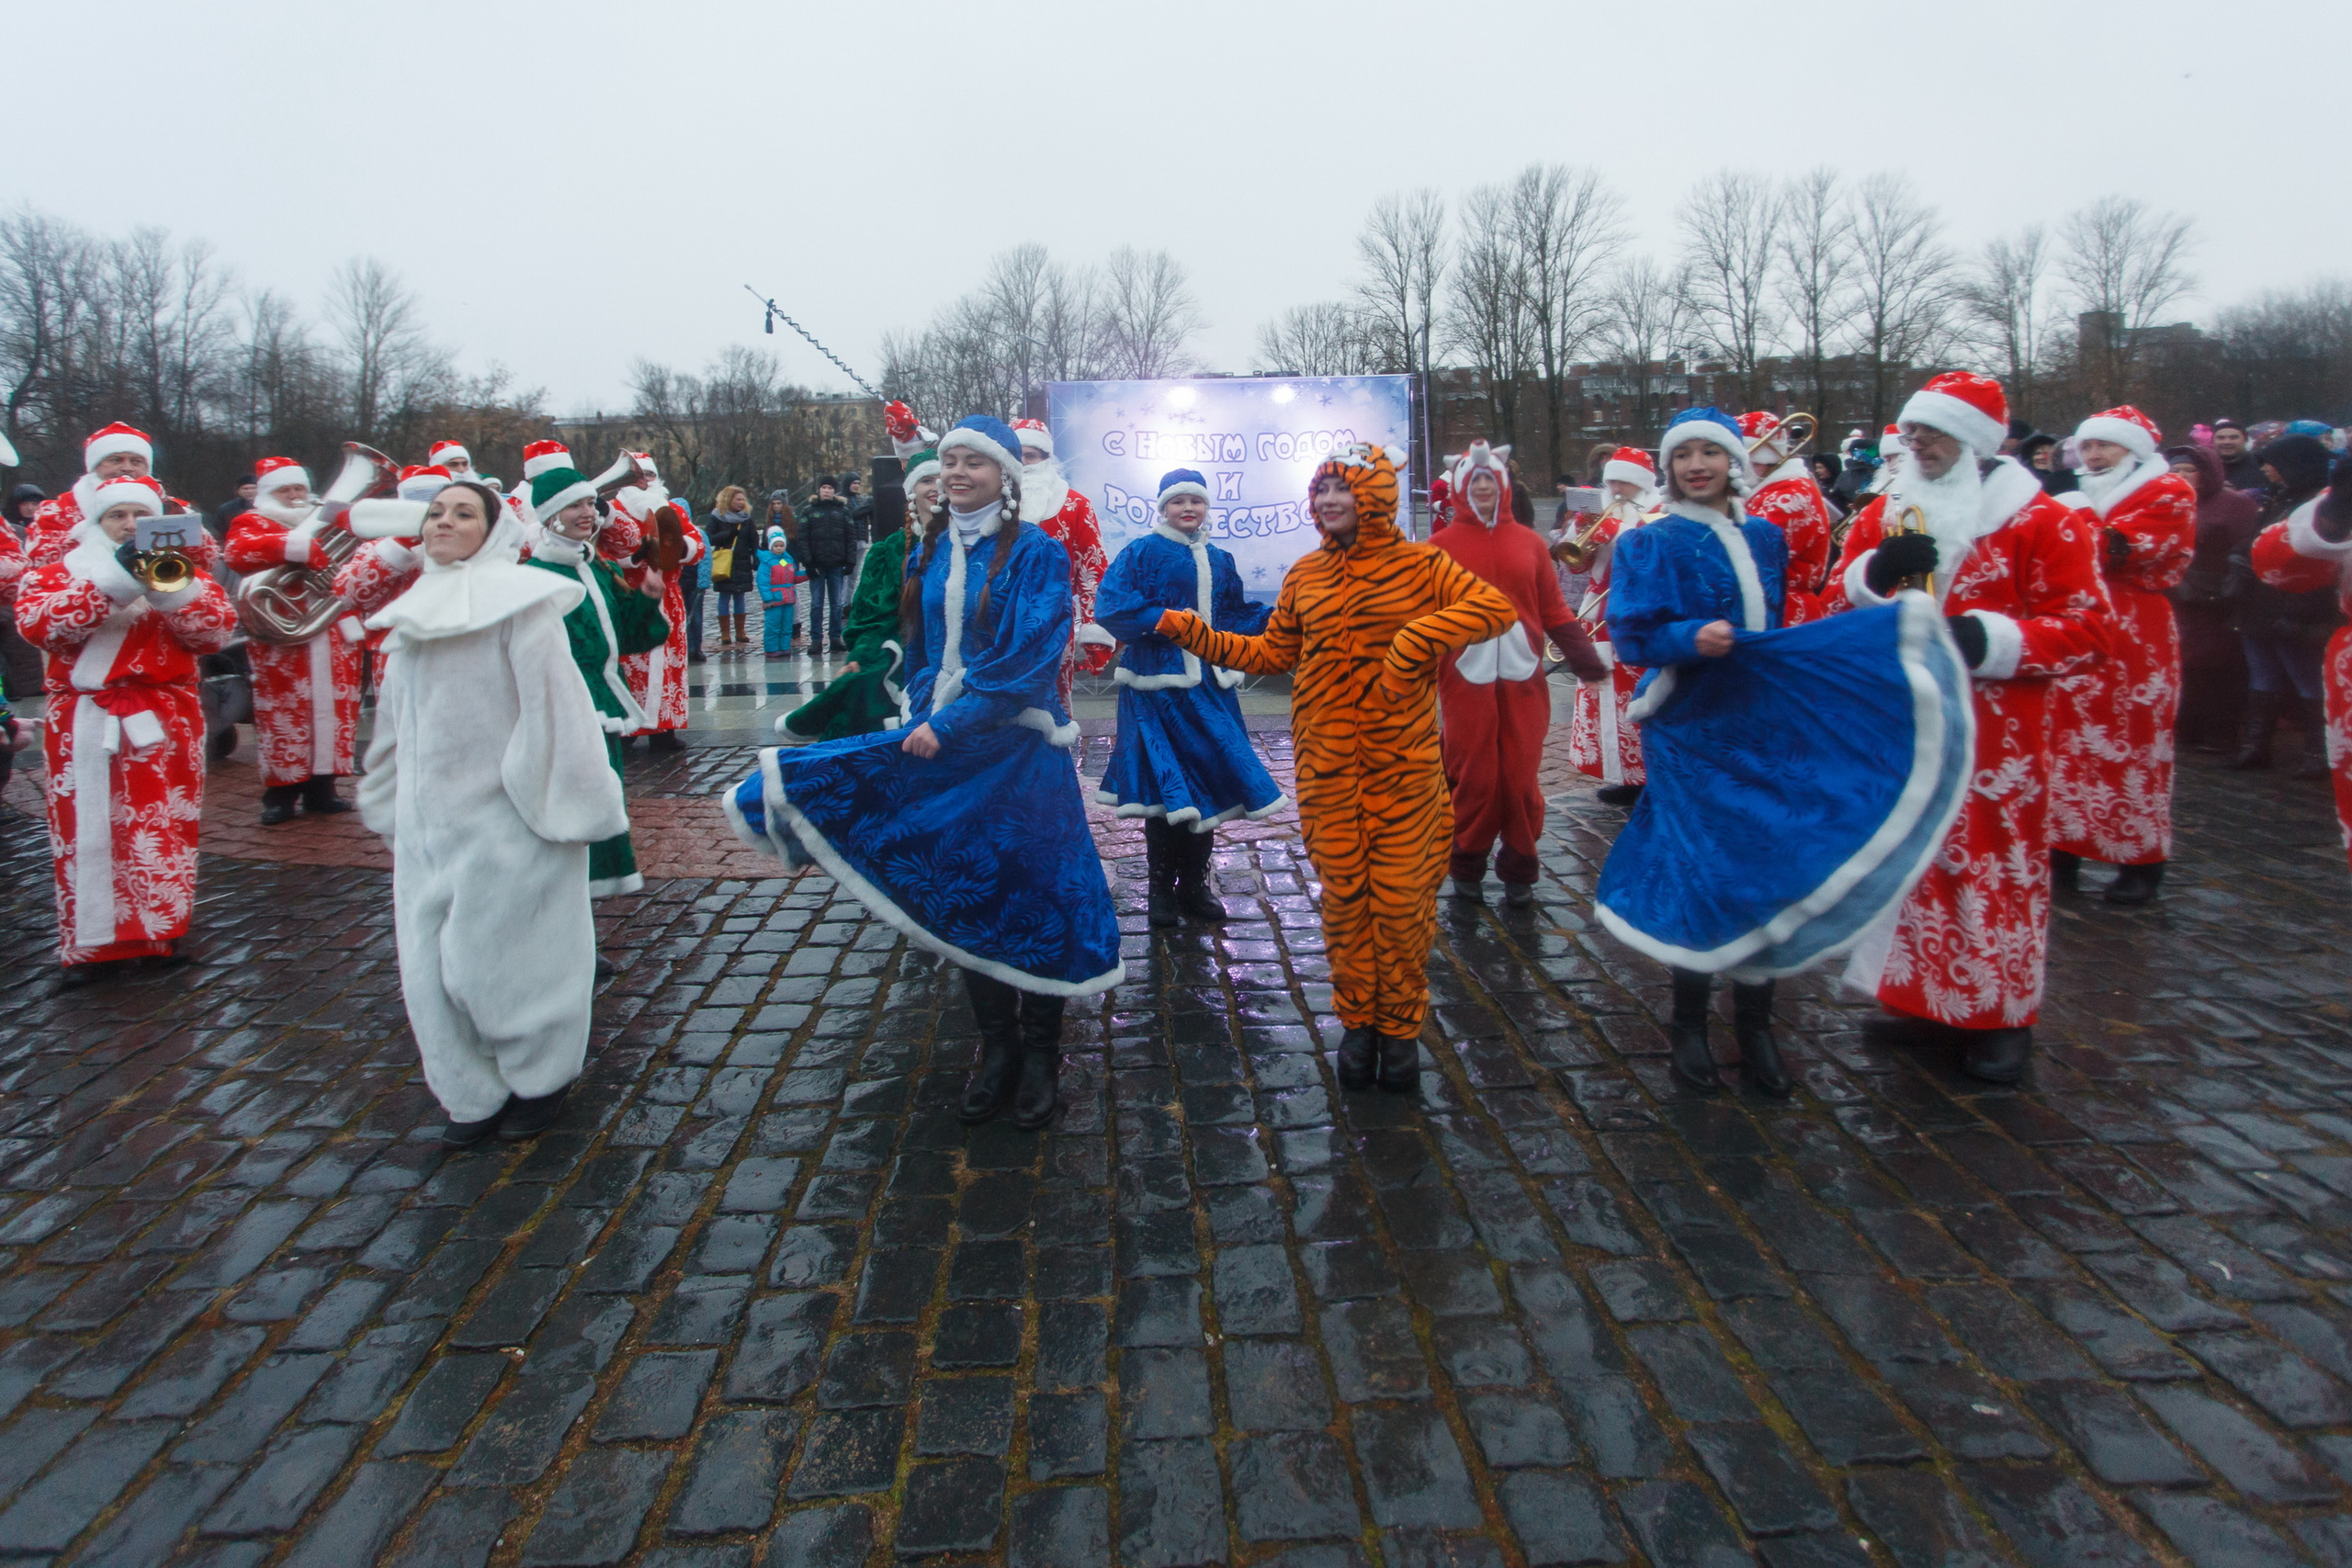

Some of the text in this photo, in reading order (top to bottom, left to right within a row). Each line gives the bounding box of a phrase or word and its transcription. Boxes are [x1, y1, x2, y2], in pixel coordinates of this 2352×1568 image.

[1102, 430, 1126, 457] С
[1135, 430, 1248, 463] НОВЫМ
[1216, 471, 1244, 502] И
[1103, 482, 1316, 539] РОЕСТВО
